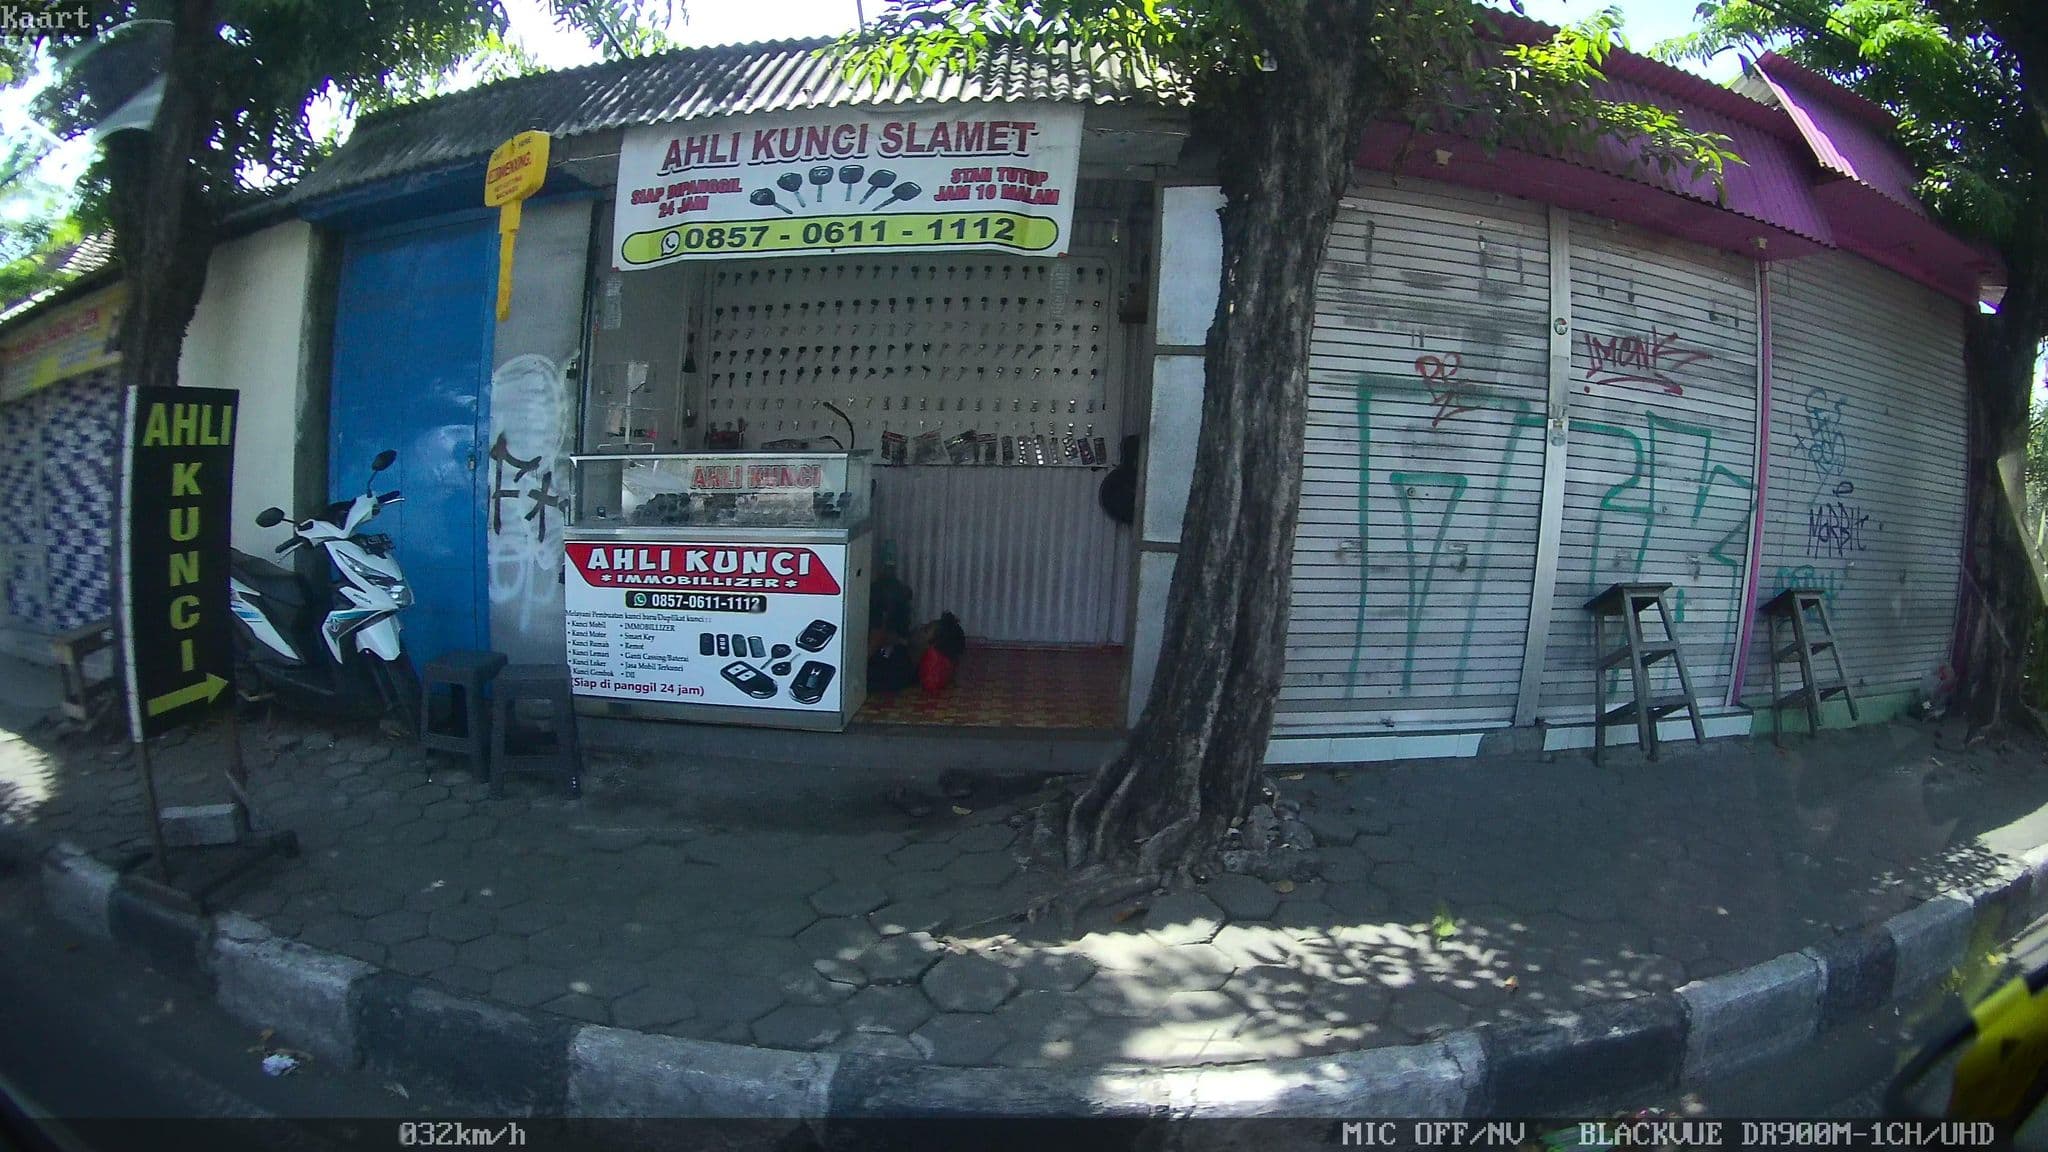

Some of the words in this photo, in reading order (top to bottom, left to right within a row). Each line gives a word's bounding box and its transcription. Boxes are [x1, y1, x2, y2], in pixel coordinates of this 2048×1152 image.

[661, 131, 741, 172] AHLI
[751, 122, 869, 161] KUNCI
[880, 121, 1036, 153] SLAMET
[950, 167, 993, 184] STAN
[996, 166, 1049, 187] TUTUP
[631, 187, 665, 205] SIAP
[667, 177, 743, 200] DIPANGGIL
[933, 184, 971, 201] JAM
[975, 184, 997, 200] 10
[1001, 186, 1061, 206] MALAM
[658, 202, 676, 219] 24
[677, 195, 710, 214] JAM
[684, 225, 770, 250] 0857
[802, 220, 887, 244] 0611
[926, 217, 1016, 242] 1112
[143, 402, 233, 447] AHLI
[689, 465, 743, 490] AHLI
[168, 461, 203, 673] KUNCI
[586, 547, 671, 571] AHLI
[685, 549, 811, 576] KUNCI
[616, 573, 780, 588] IMMOBILLIZER
[651, 593, 761, 612] 0857-0611-1112
[643, 633, 655, 643] Key
[599, 677, 612, 689] di
[614, 680, 657, 694] panggil
[660, 683, 675, 693] 24
[677, 684, 705, 697] jam)
